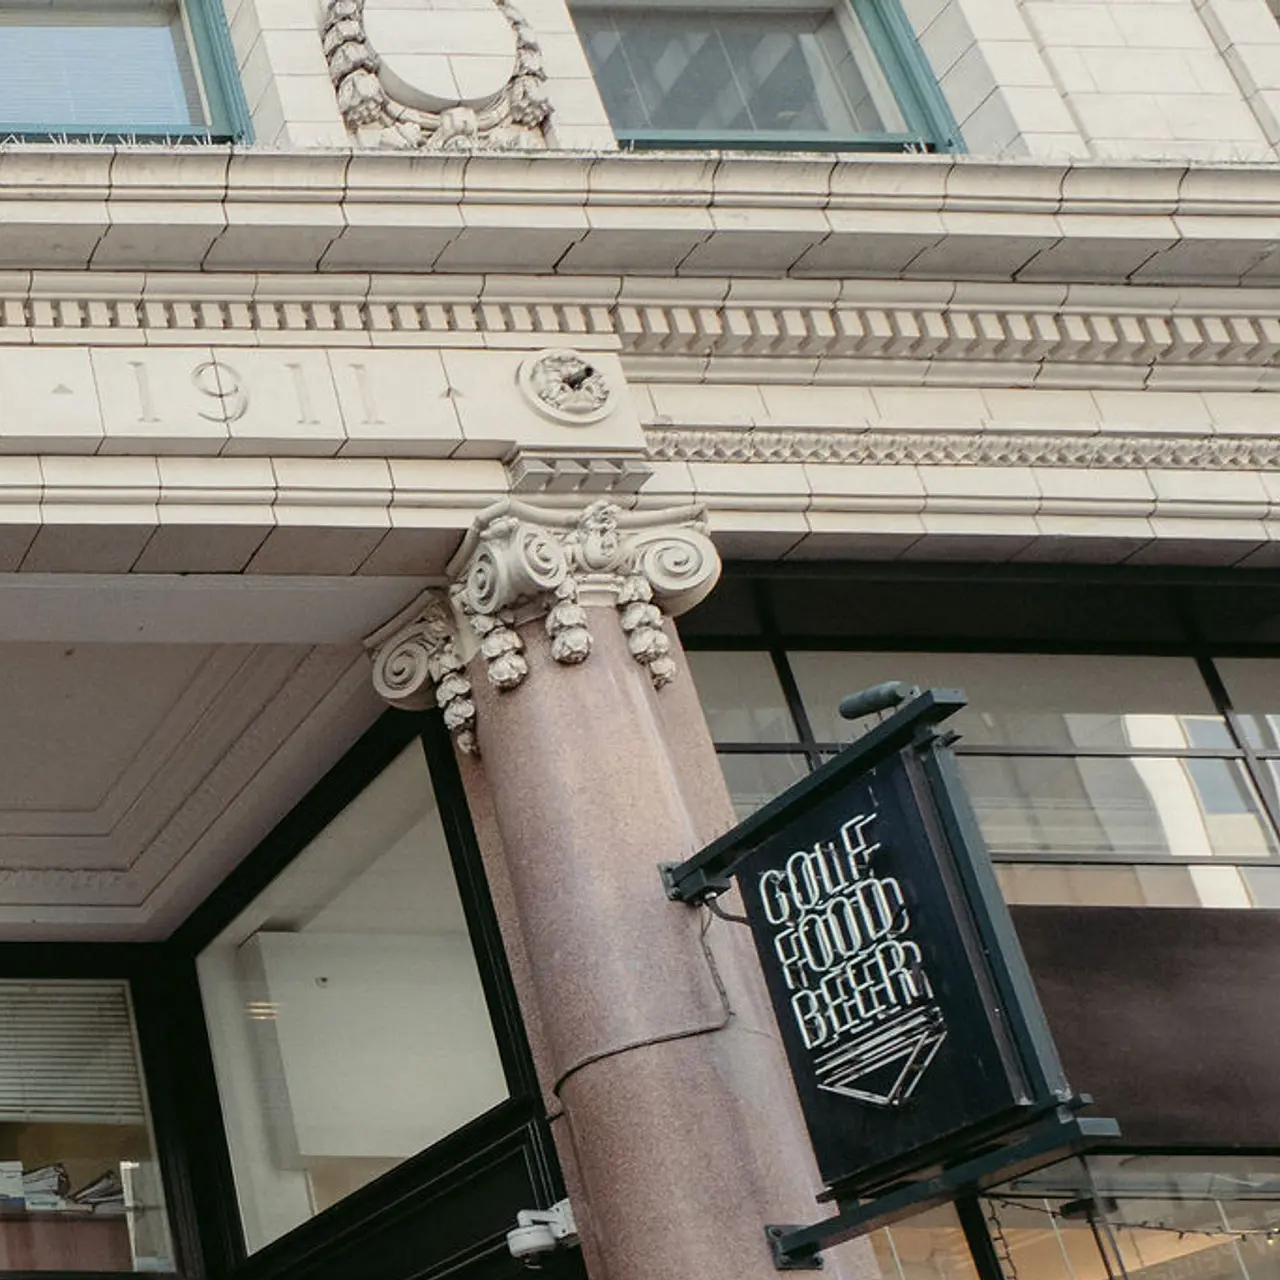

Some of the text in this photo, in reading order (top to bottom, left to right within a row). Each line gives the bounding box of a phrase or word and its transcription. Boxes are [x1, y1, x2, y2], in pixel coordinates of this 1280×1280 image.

[132, 355, 386, 424] 1911
[759, 813, 881, 926] GOLF
[774, 877, 910, 990] FOOD
[792, 940, 935, 1050] BEER
